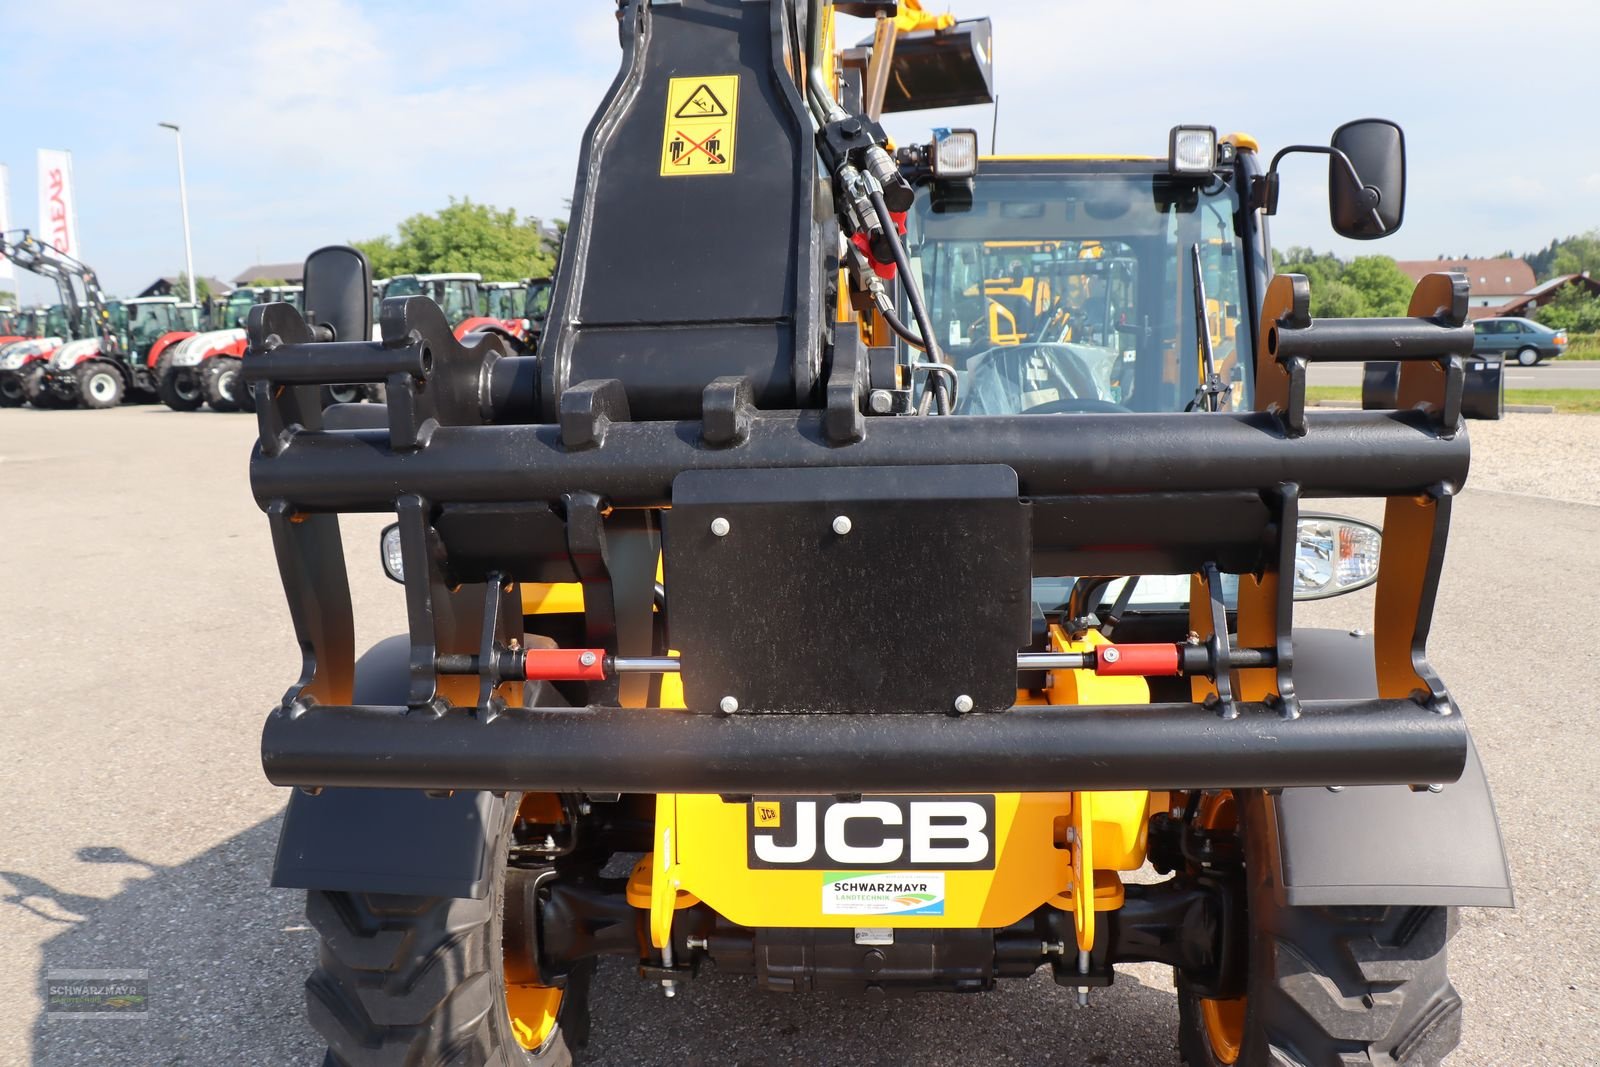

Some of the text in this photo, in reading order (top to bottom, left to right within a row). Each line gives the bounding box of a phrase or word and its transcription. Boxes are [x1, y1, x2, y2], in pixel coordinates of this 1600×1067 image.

[760, 808, 776, 820] JCB
[754, 801, 989, 863] JCB
[834, 882, 928, 893] SCHWARZMAYR
